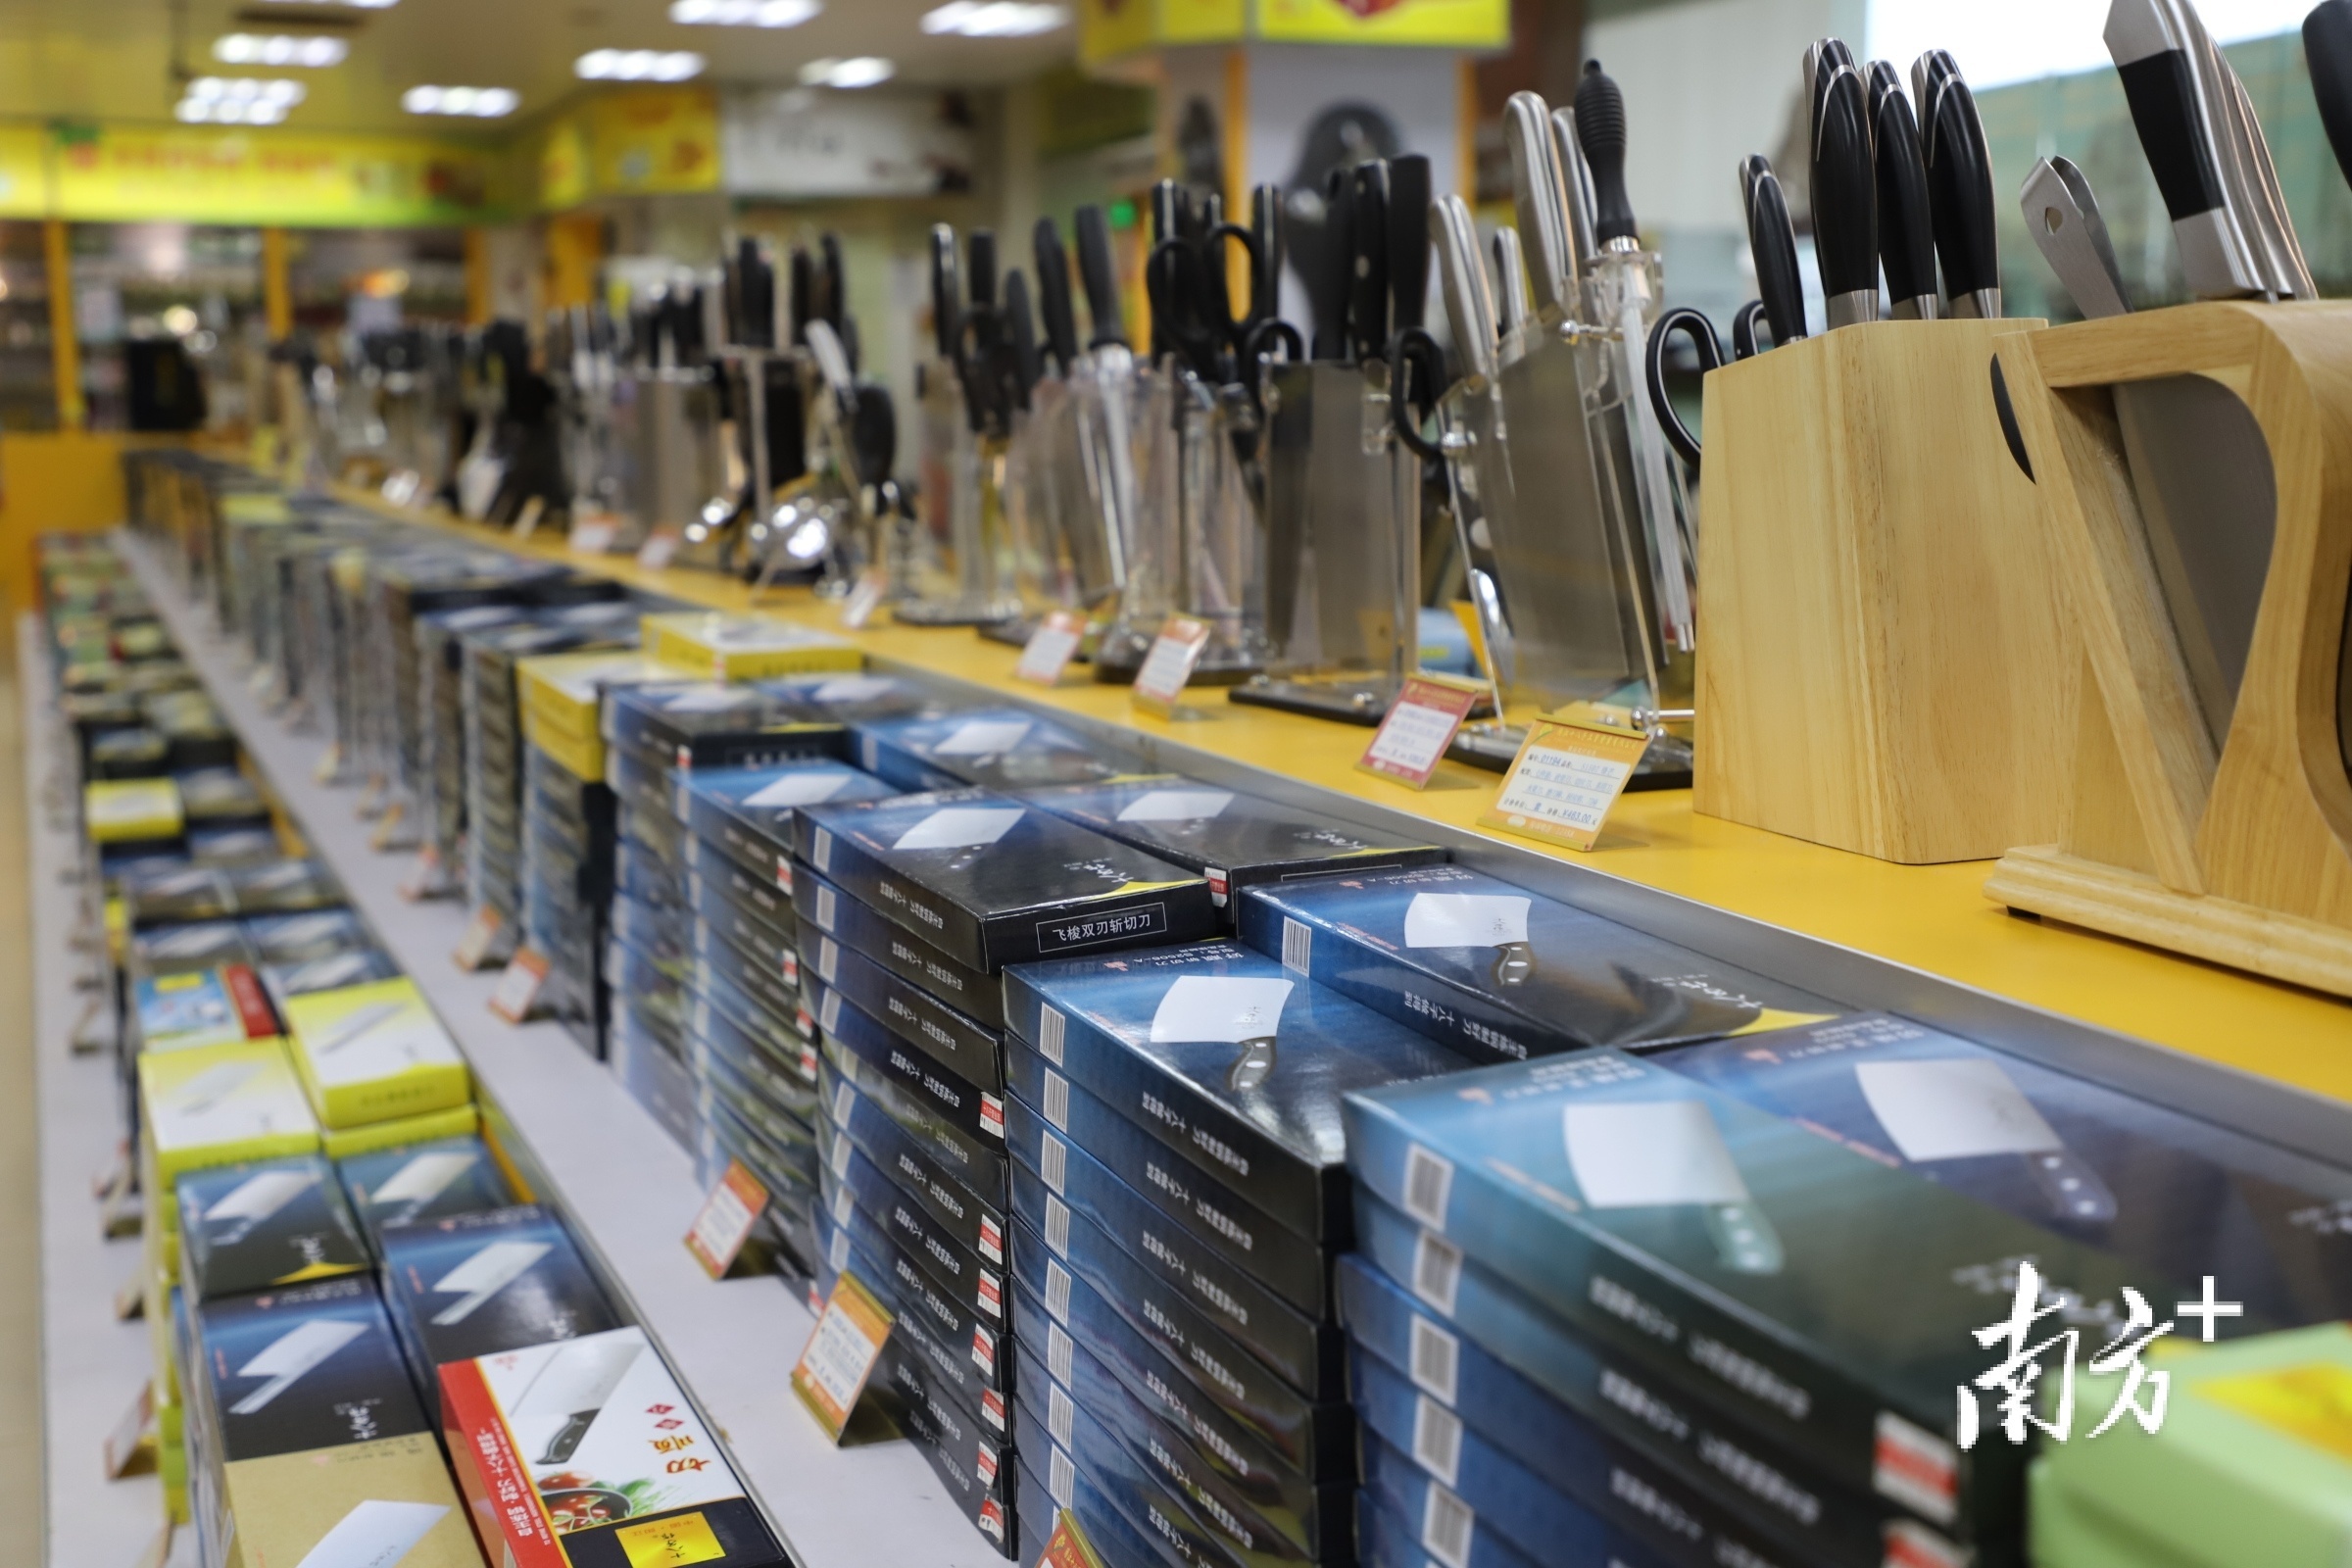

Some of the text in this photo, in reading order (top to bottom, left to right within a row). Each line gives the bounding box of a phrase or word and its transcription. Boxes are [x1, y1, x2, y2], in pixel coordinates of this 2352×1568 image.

[1053, 913, 1151, 941] 飞梭双刃斩切刀
[661, 1533, 686, 1559] 十八子作
